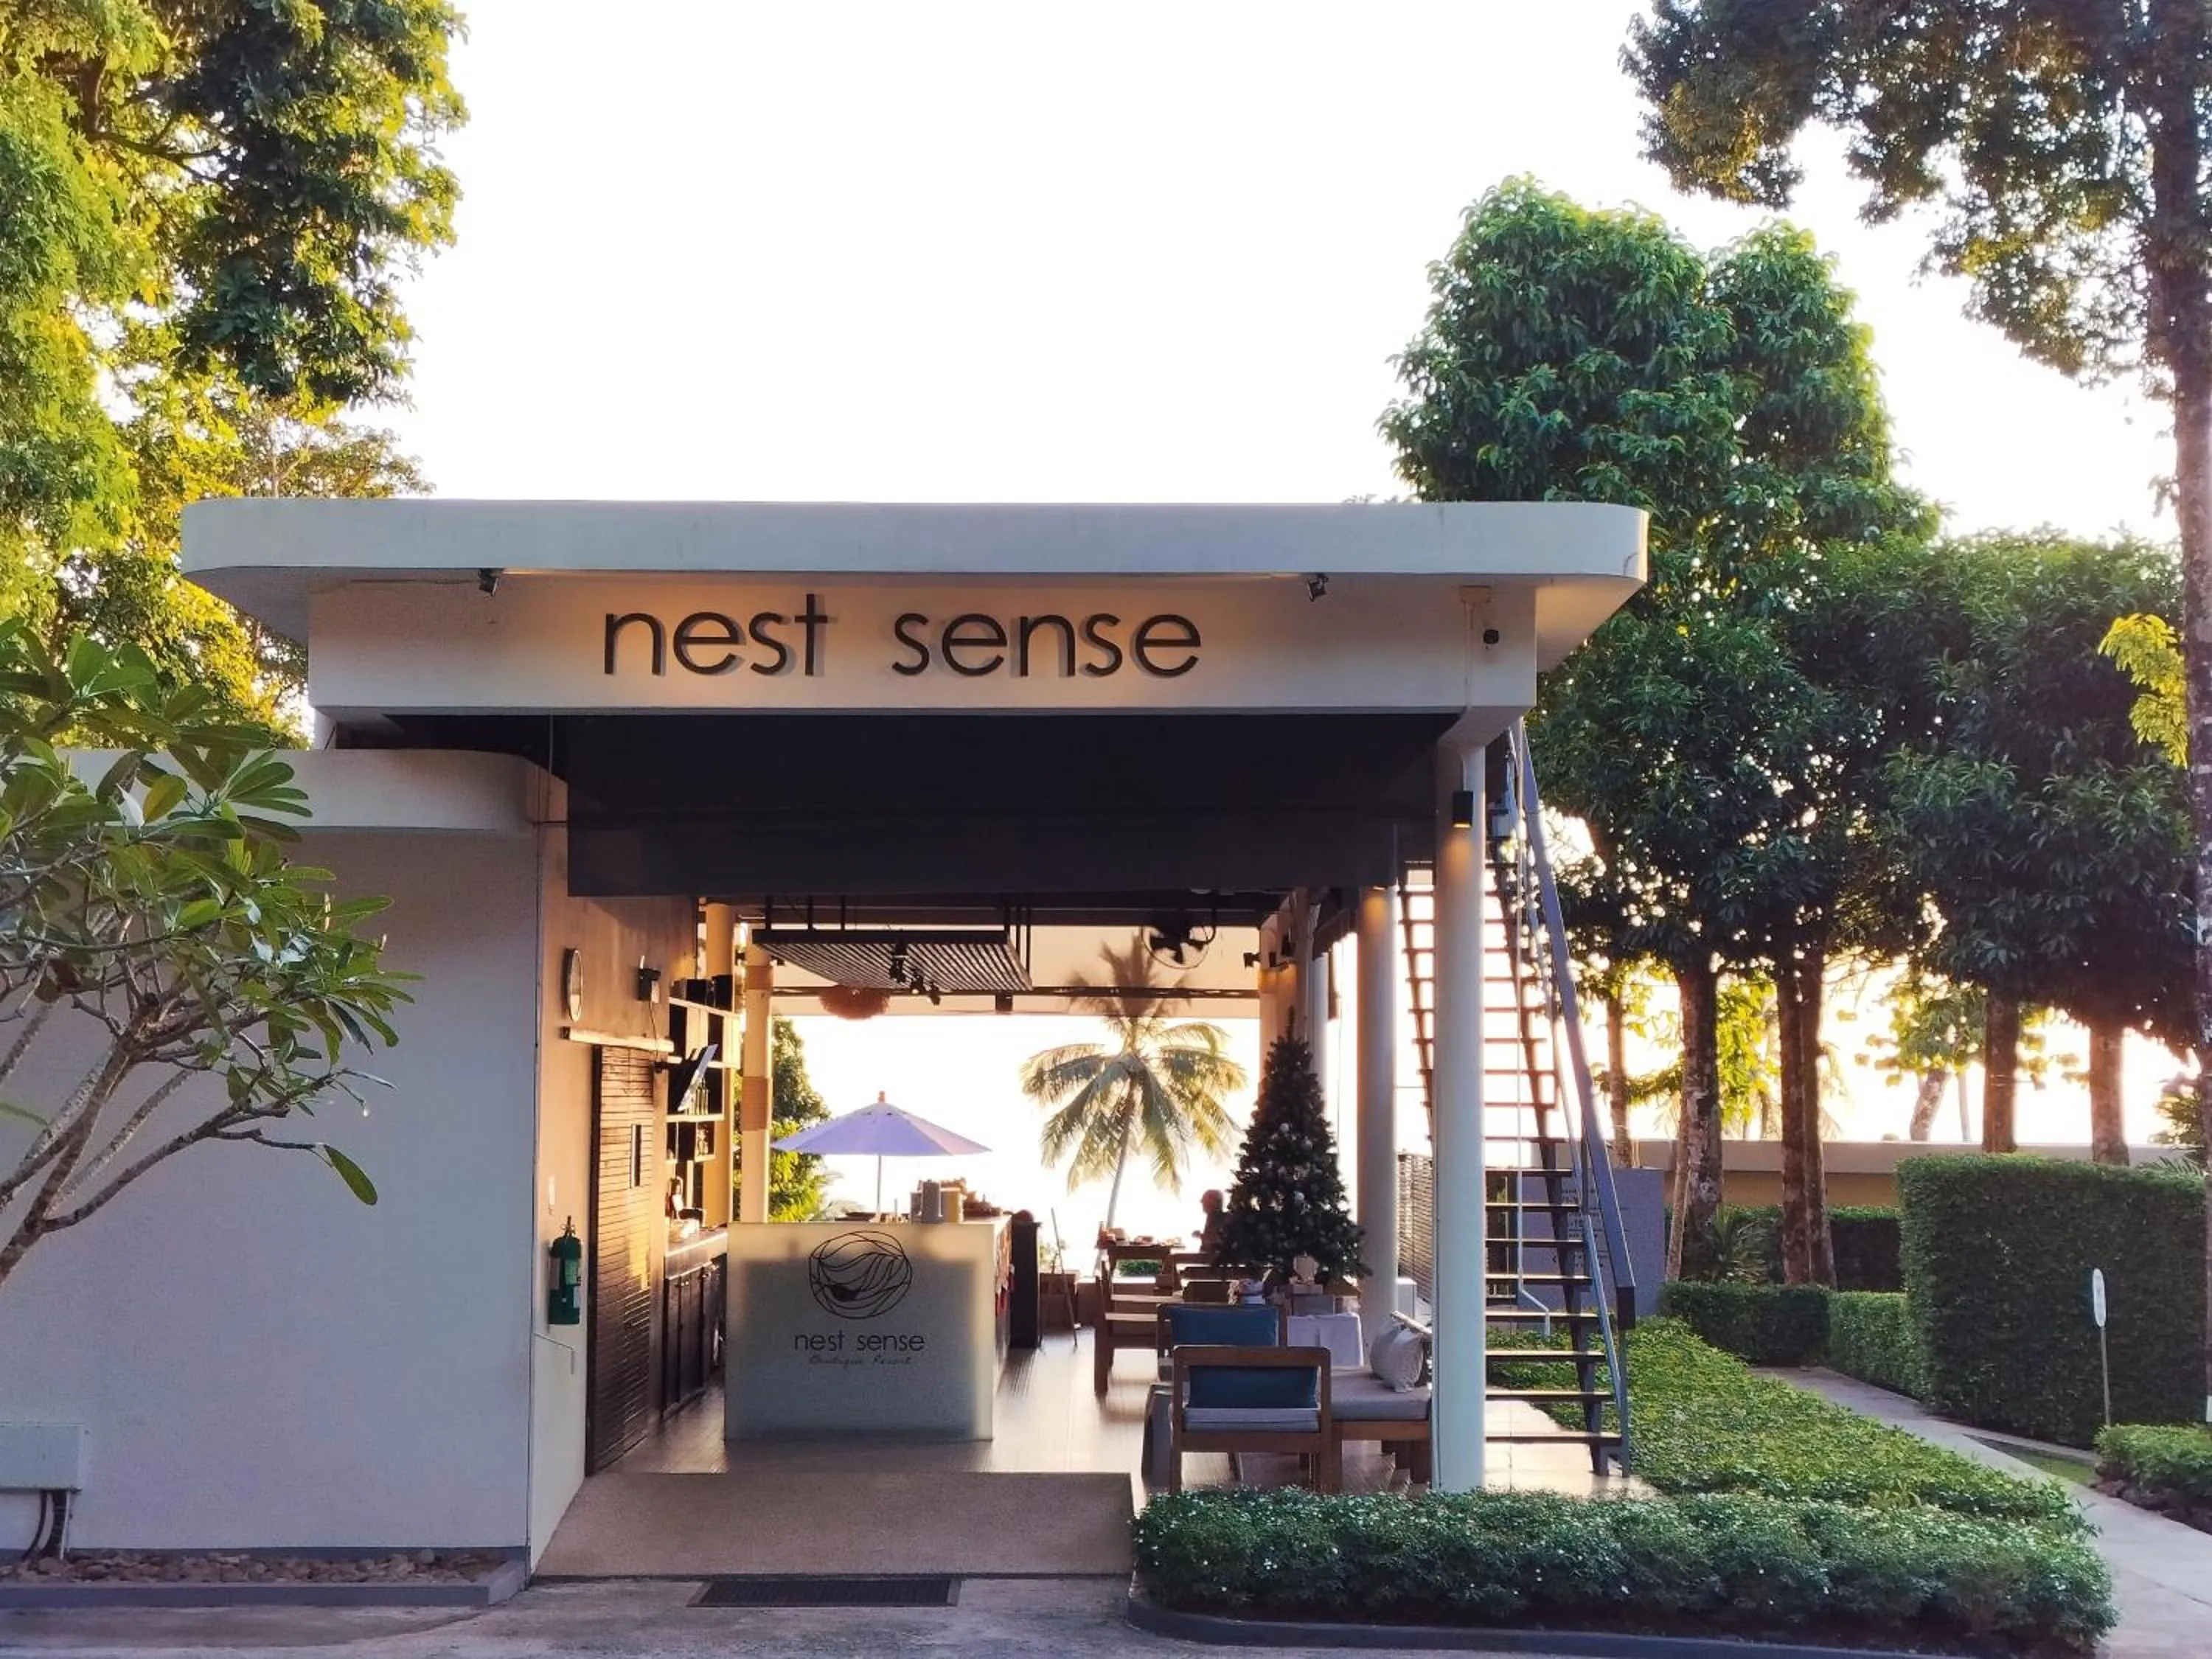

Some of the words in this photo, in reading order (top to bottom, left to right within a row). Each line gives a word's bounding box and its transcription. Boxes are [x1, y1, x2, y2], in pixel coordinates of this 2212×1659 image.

[604, 594, 829, 676] nest
[891, 612, 1202, 677] sense
[793, 1329, 846, 1352] nest
[856, 1334, 925, 1352] sense
